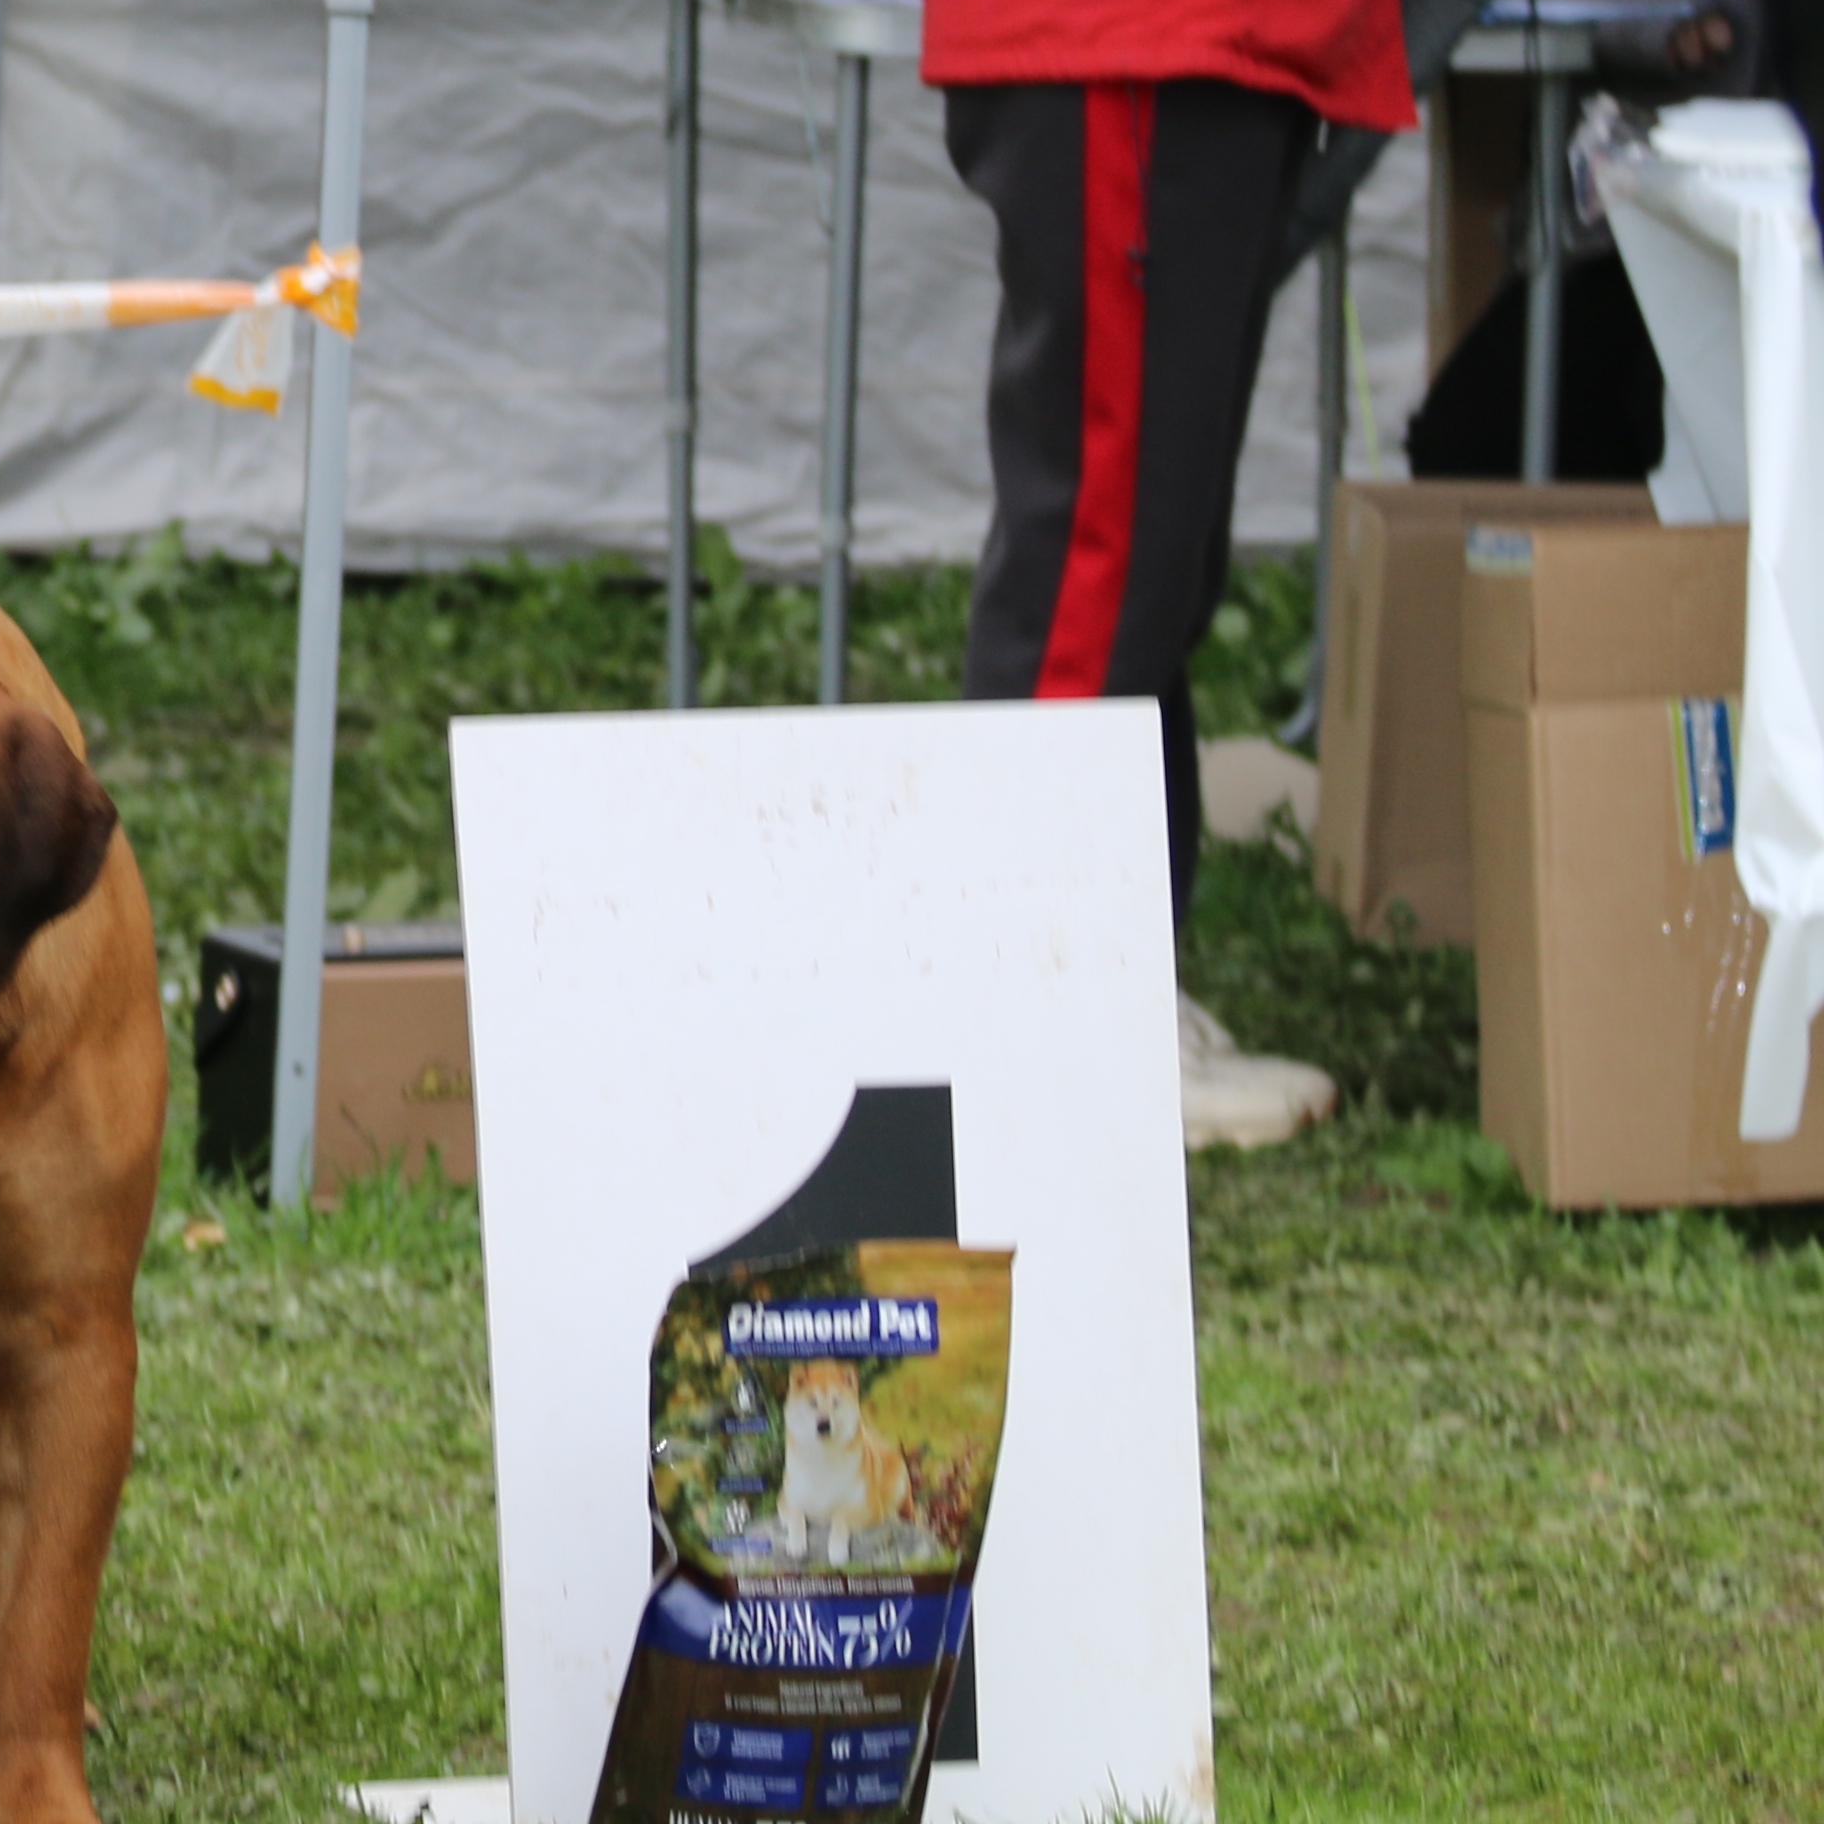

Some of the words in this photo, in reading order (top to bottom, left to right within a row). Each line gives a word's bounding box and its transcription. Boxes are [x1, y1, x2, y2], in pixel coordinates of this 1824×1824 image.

[728, 1299, 871, 1343] Diamond
[878, 1298, 932, 1342] Pet
[837, 1596, 913, 1669] 75%
